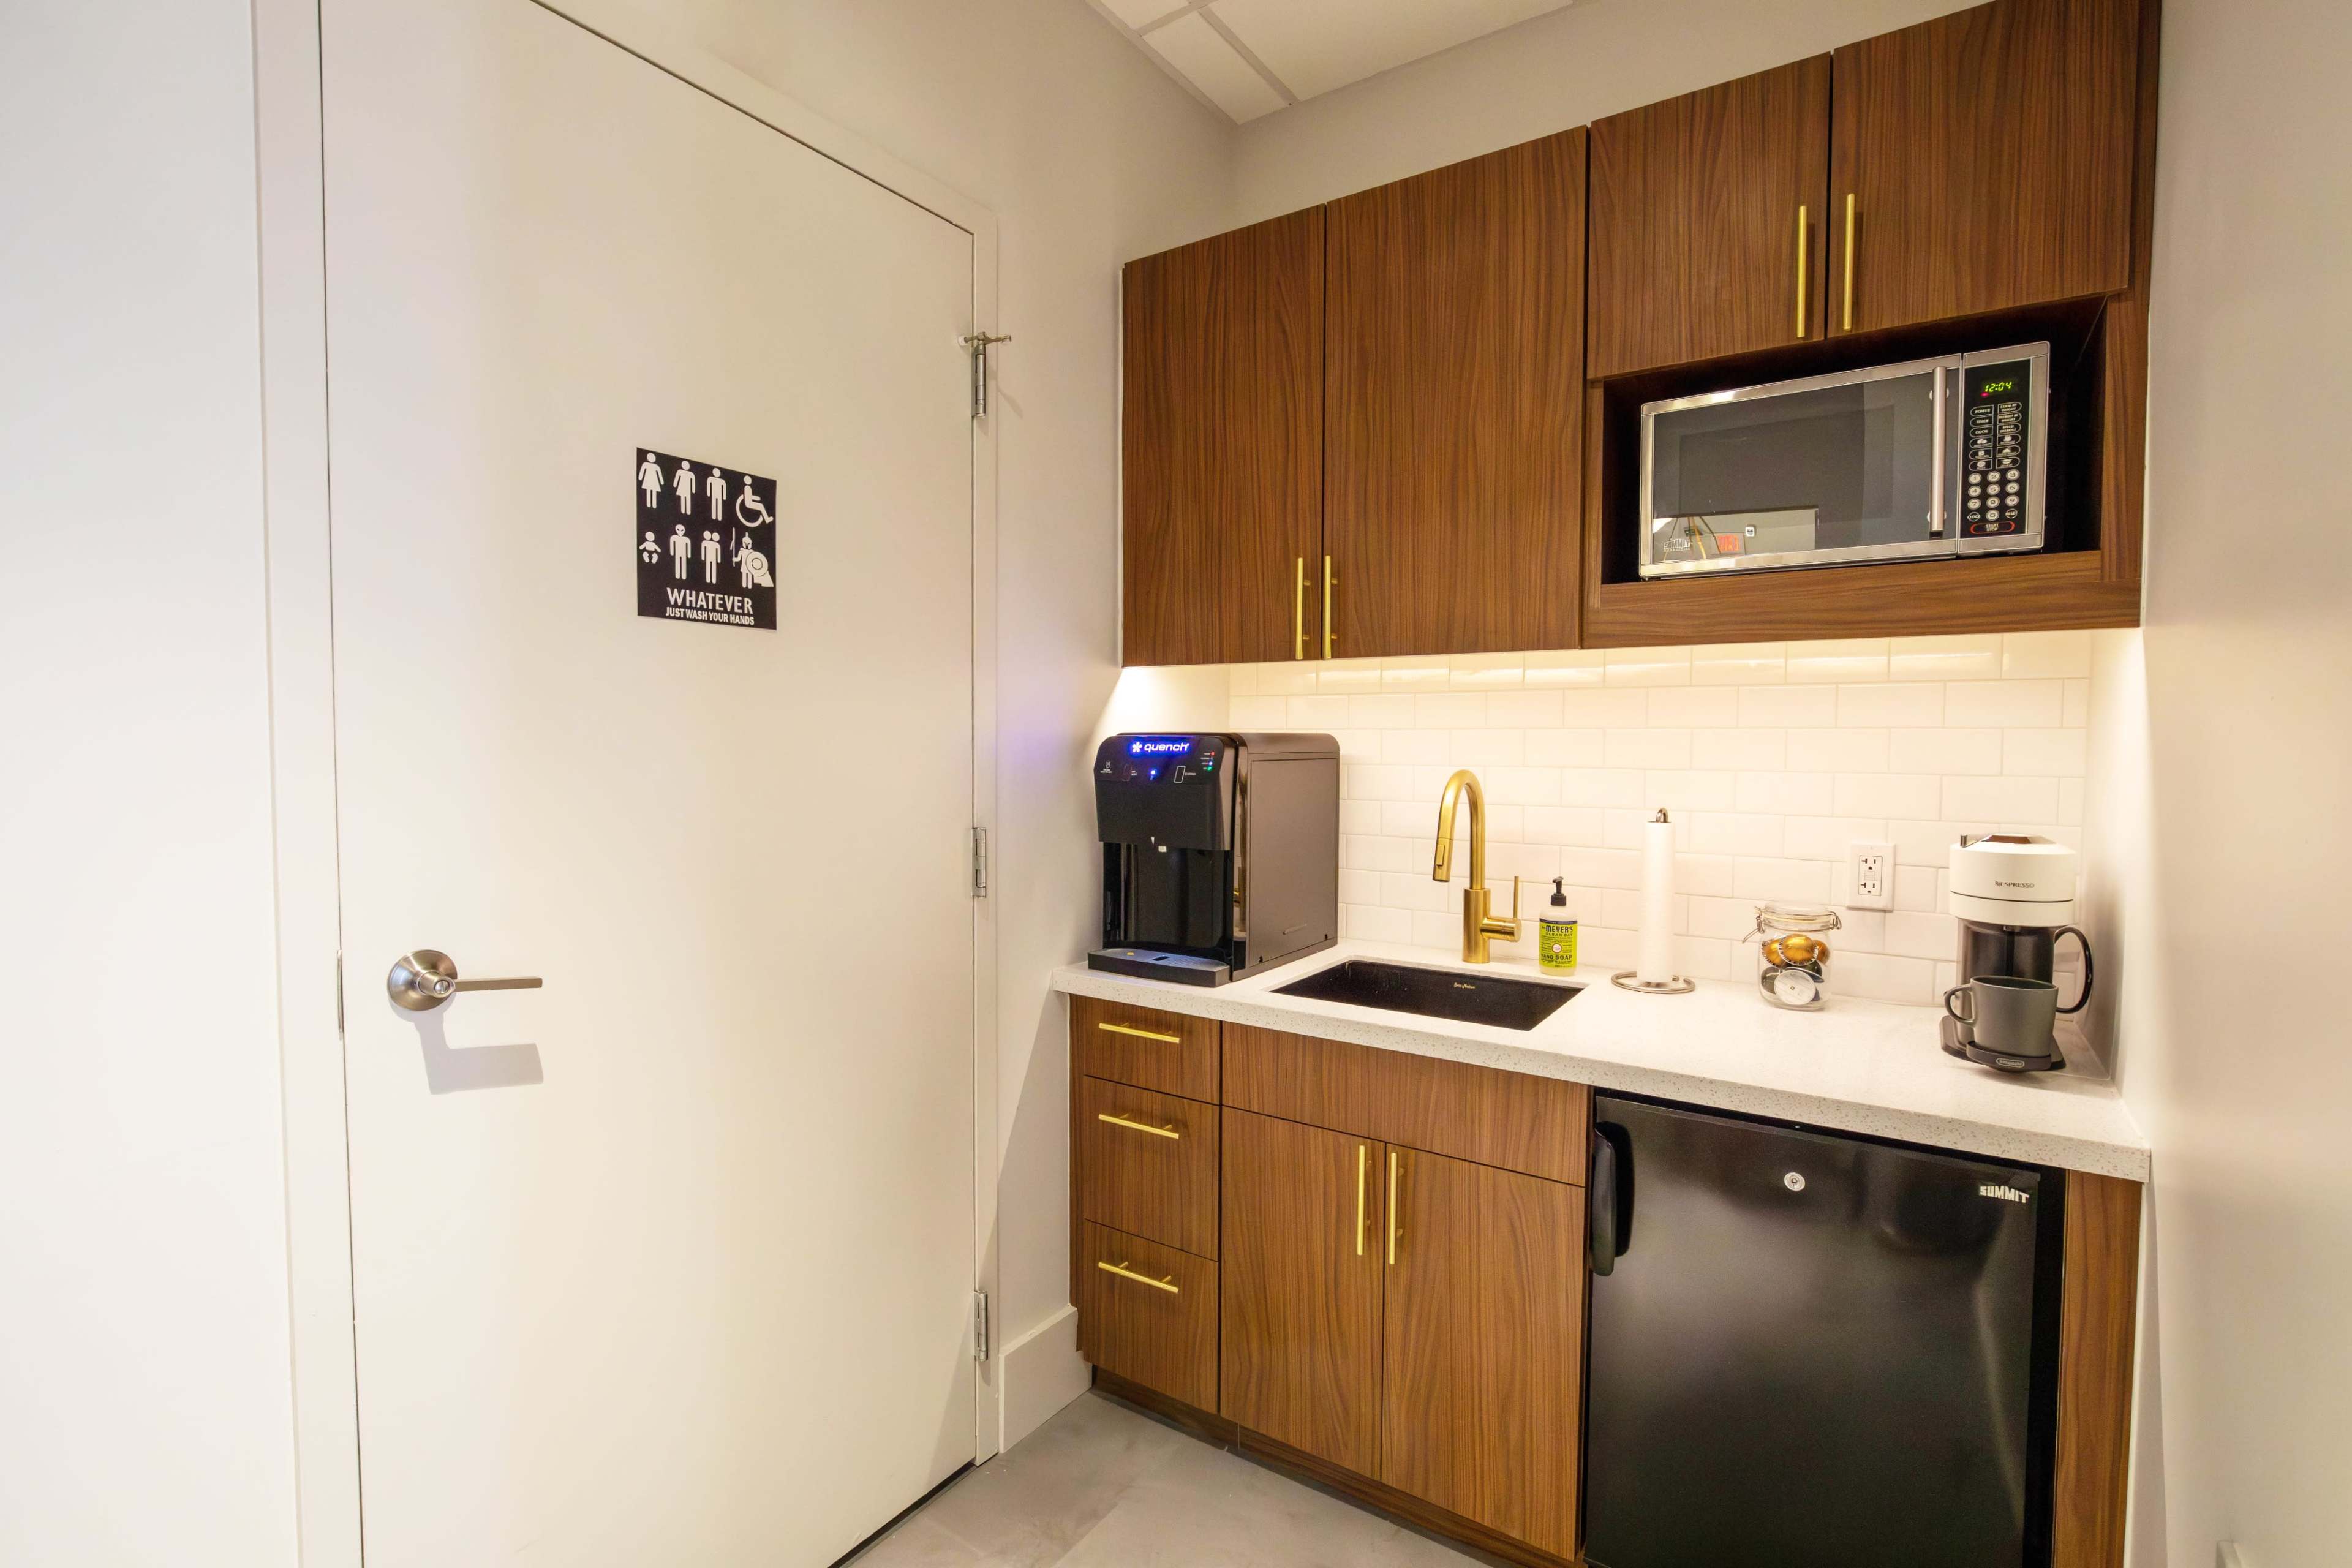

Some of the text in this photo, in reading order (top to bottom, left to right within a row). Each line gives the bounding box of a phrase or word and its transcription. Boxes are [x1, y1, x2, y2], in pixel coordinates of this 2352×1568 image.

[1985, 382, 2012, 392] 12:04
[1664, 539, 1691, 548] SUMMIT
[666, 587, 753, 614] WHATEVER
[666, 606, 755, 625] JUST WASH YOUR HANDS
[1144, 742, 1189, 753] quench
[1980, 1185, 2030, 1204] SUMMIT
